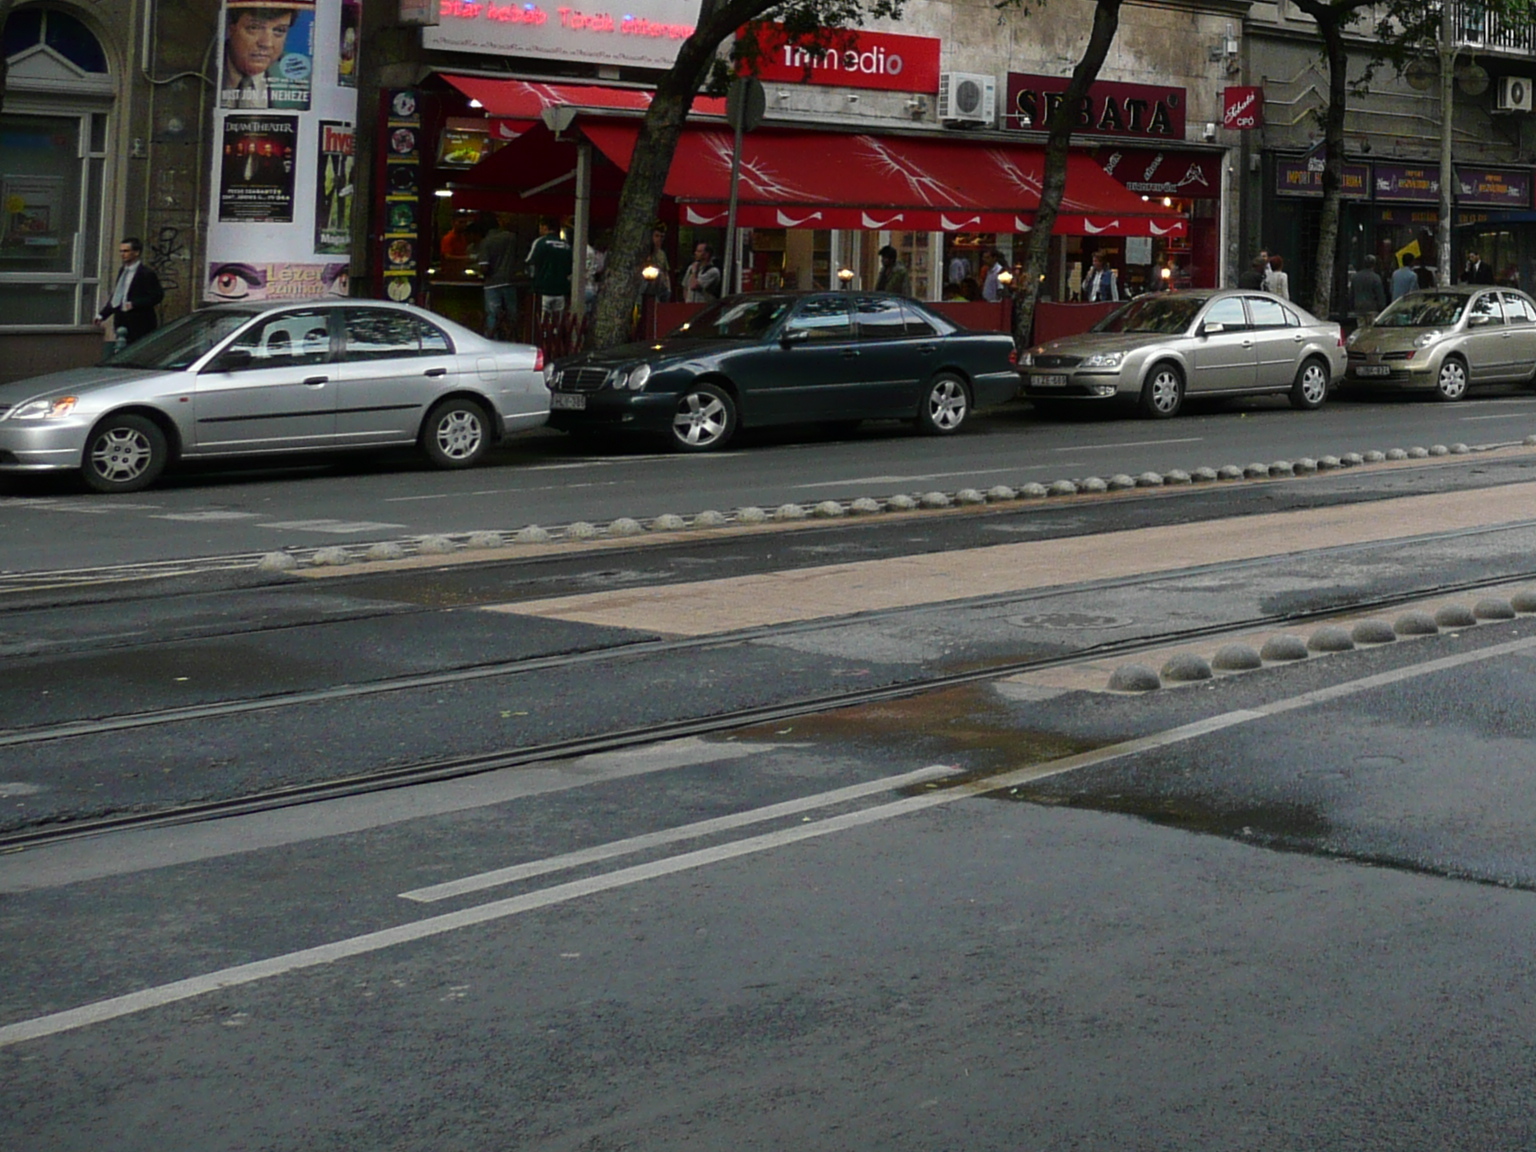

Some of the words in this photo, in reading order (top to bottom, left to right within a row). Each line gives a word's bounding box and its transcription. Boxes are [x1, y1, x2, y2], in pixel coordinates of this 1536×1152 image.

[487, 1, 548, 26] kebab
[556, 6, 614, 33] Török
[1016, 89, 1175, 135] SEBATA
